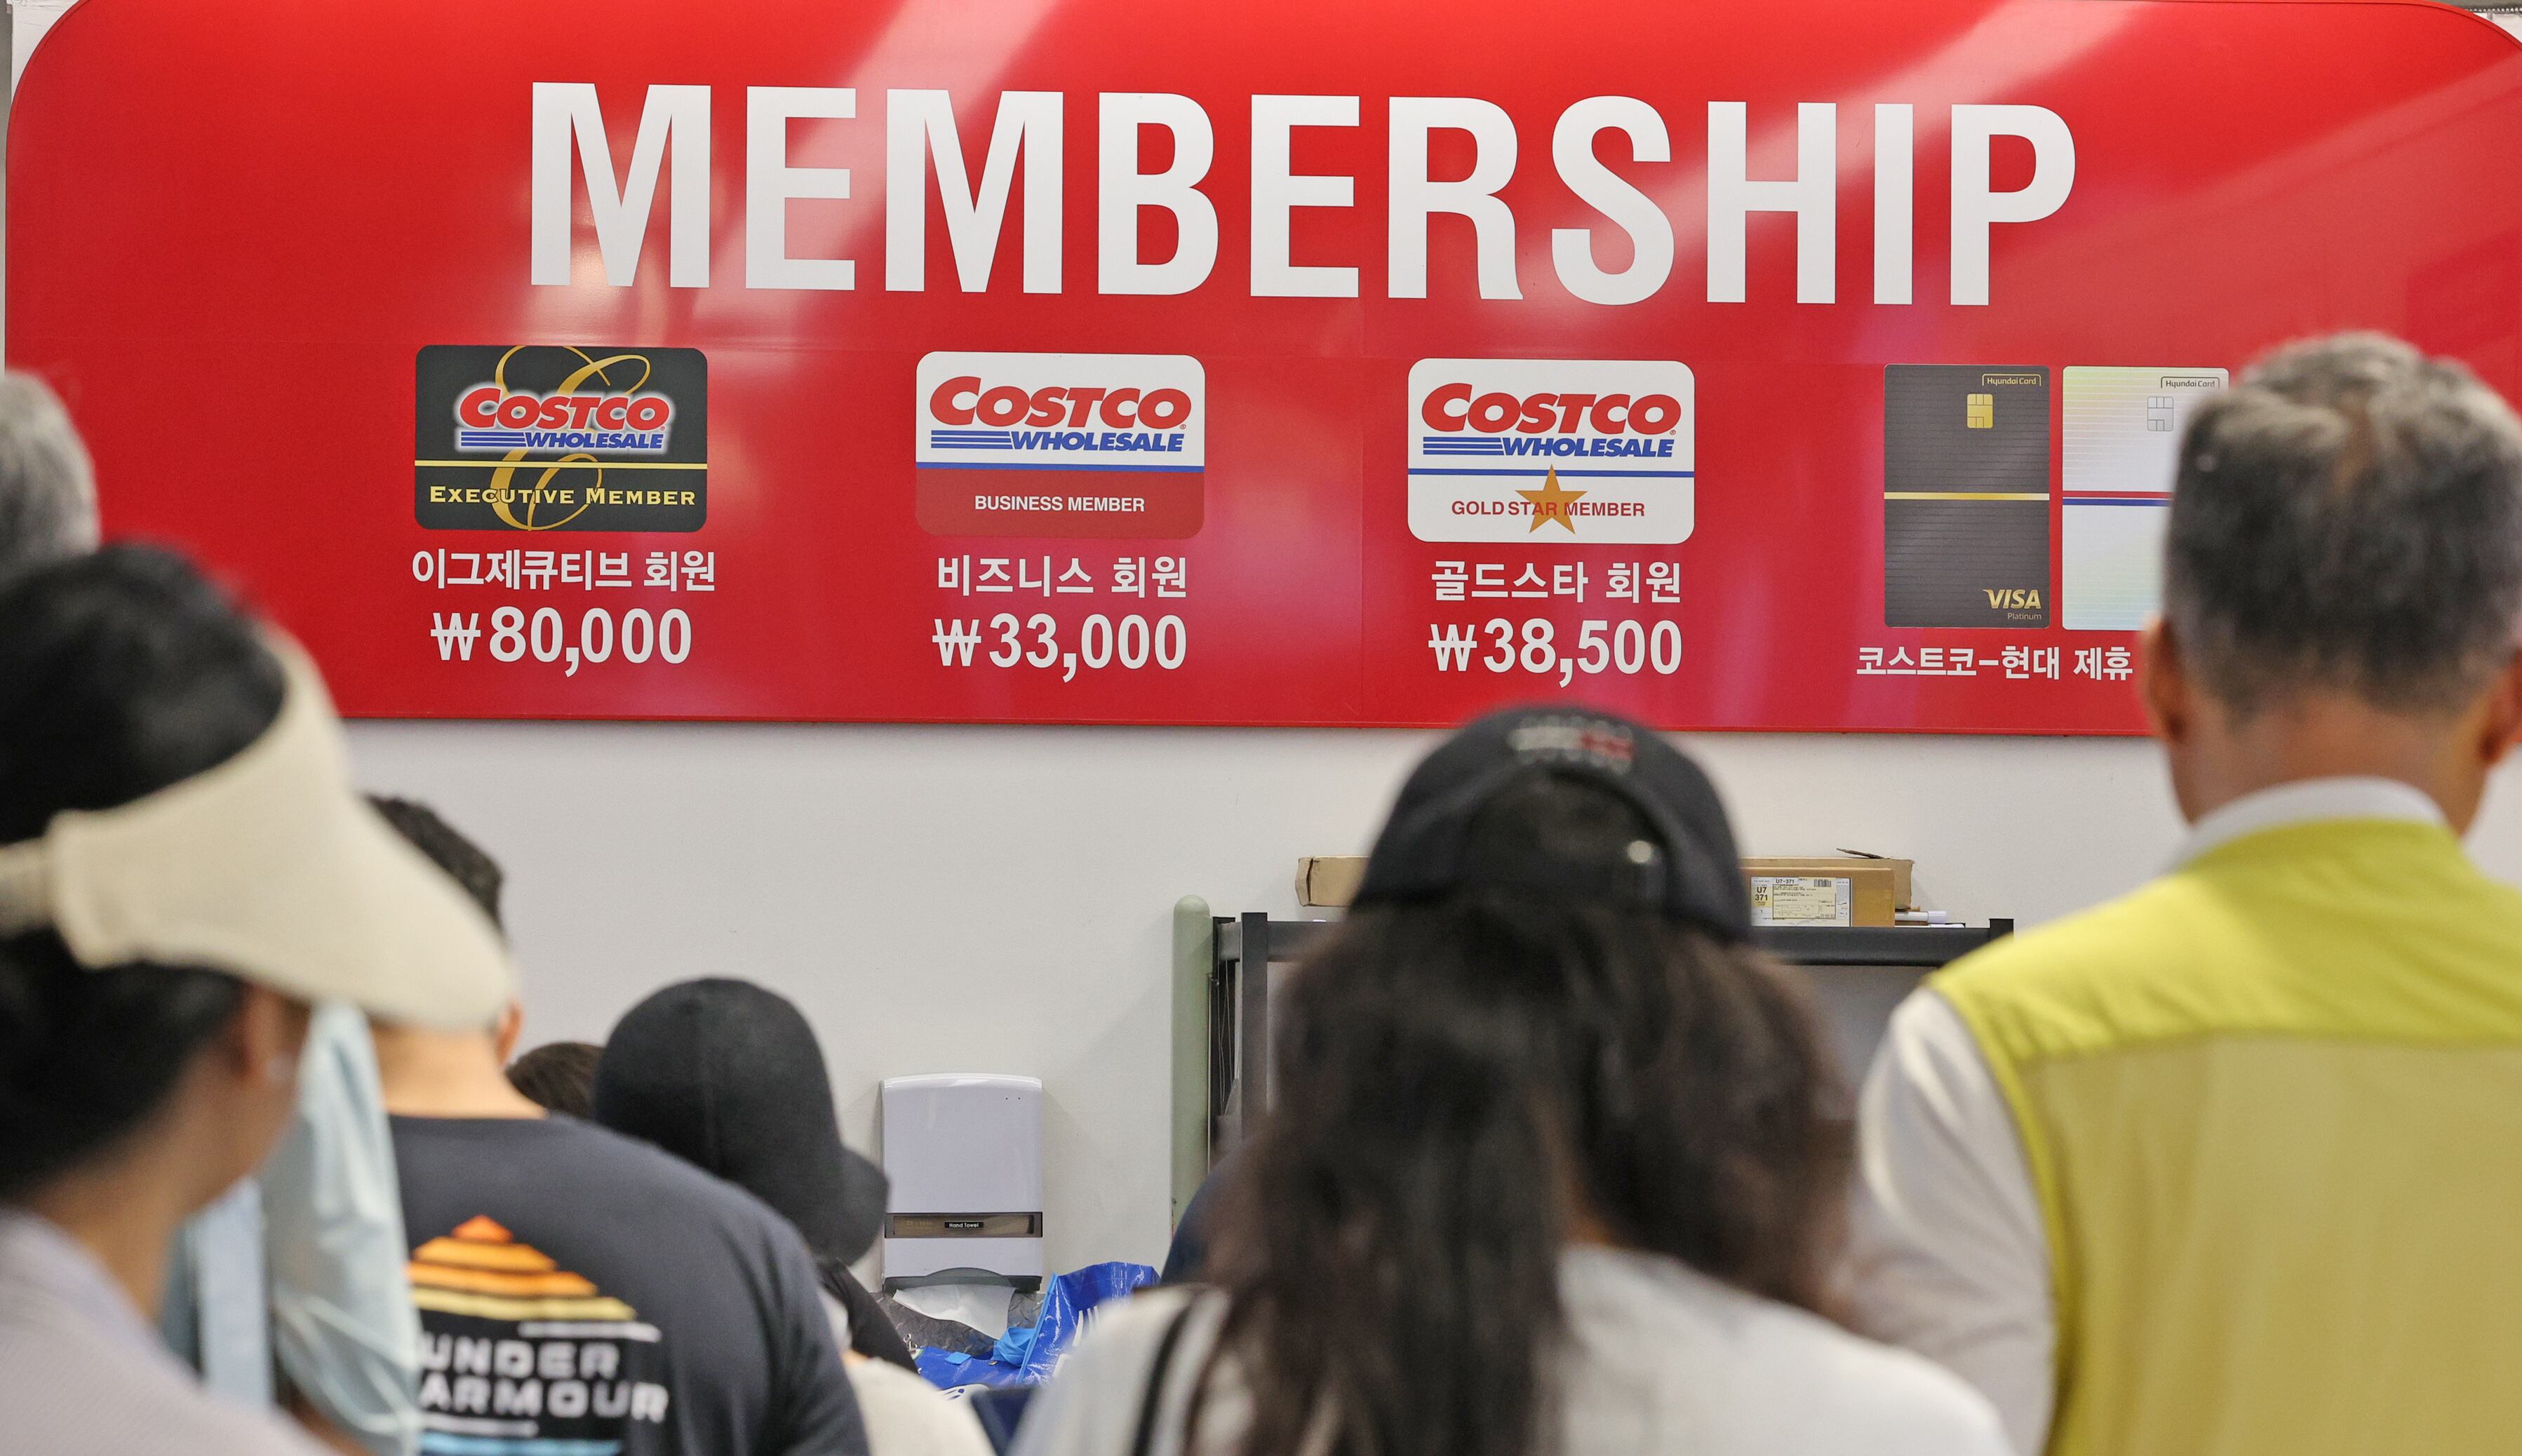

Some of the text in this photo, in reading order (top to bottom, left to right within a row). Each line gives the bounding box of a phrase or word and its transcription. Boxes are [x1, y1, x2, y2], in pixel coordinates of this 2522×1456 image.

[531, 81, 2077, 305] MEMBERSHIP
[460, 387, 670, 431] COSTCO
[930, 376, 1192, 429] COSTCO
[1421, 382, 1682, 435] COSTCO
[525, 431, 663, 449] WHOLESALE
[1011, 431, 1184, 452] WHOLESALE
[1501, 437, 1675, 457] WHOLESALE
[429, 485, 696, 506] EXECUTIVE MEMBER
[974, 495, 1145, 513] BUSINESS MEMBER
[1451, 500, 1645, 517] GOLD STAR MEMBER
[411, 548, 716, 592] 이그제큐티브 회원
[938, 555, 1187, 598] 비즈니스 회원
[1431, 560, 1680, 604] 골드스타 회원
[1983, 588, 2041, 609] VISA
[430, 606, 692, 678] ₩80,000
[932, 612, 1186, 682] ₩33,000
[1428, 617, 1682, 688] ₩38,500
[1856, 645, 2133, 681] 코스트코-현대 제휴
[420, 1330, 622, 1379] UNDER
[419, 1372, 670, 1424] ARMOUR
